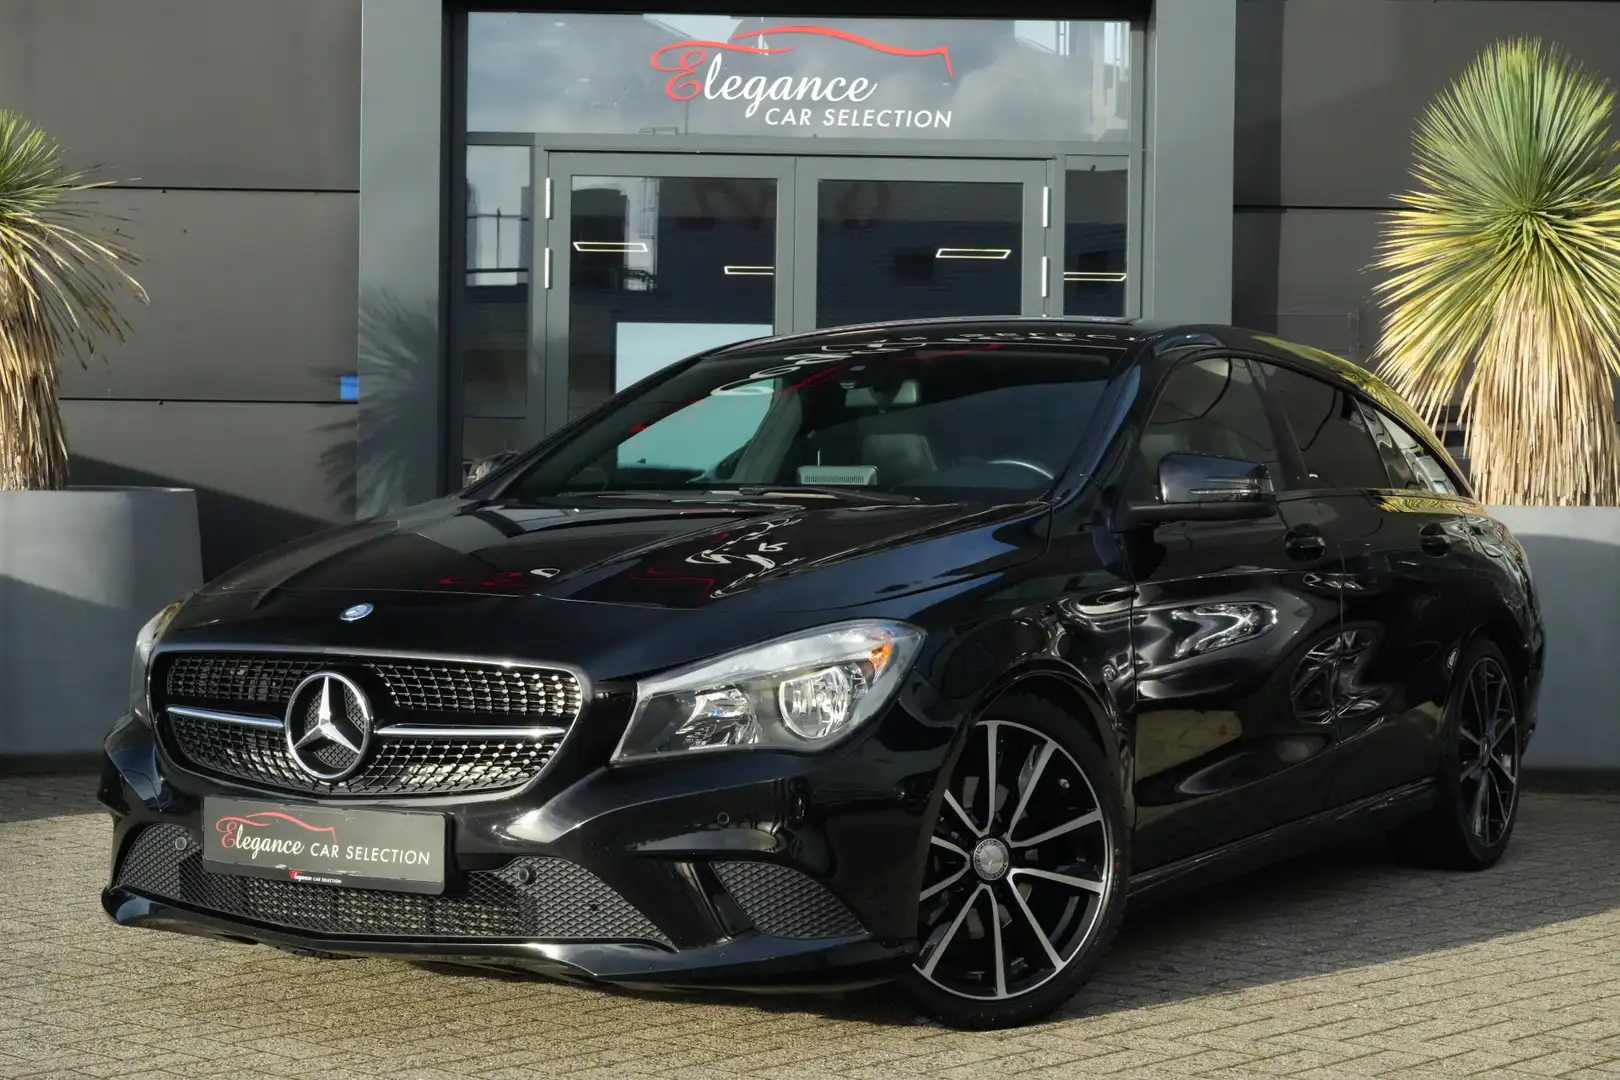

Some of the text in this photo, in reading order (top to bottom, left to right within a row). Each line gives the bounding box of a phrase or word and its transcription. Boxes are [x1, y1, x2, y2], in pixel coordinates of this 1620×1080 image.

[651, 43, 877, 118] Elegance
[765, 108, 952, 128] CAR SELECTION
[216, 819, 431, 865] Elegance CAR SELECTION
